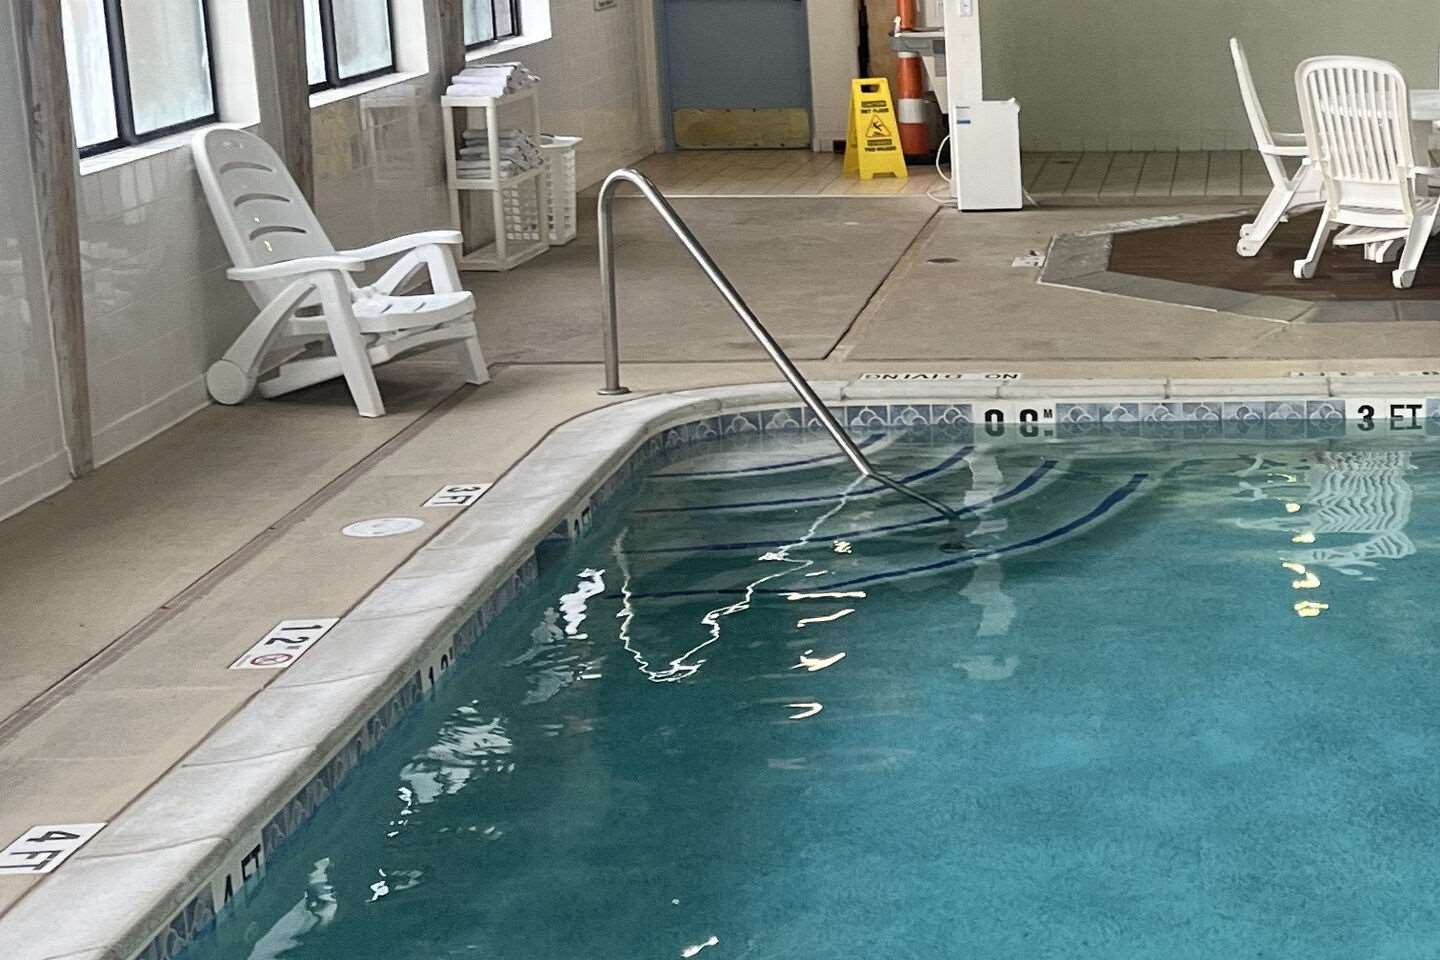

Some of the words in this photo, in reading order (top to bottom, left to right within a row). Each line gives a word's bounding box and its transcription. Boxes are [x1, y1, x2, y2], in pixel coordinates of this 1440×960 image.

[446, 486, 481, 494] 3
[431, 495, 472, 505] FT
[26, 829, 81, 843] 4
[0, 849, 66, 871] FT
